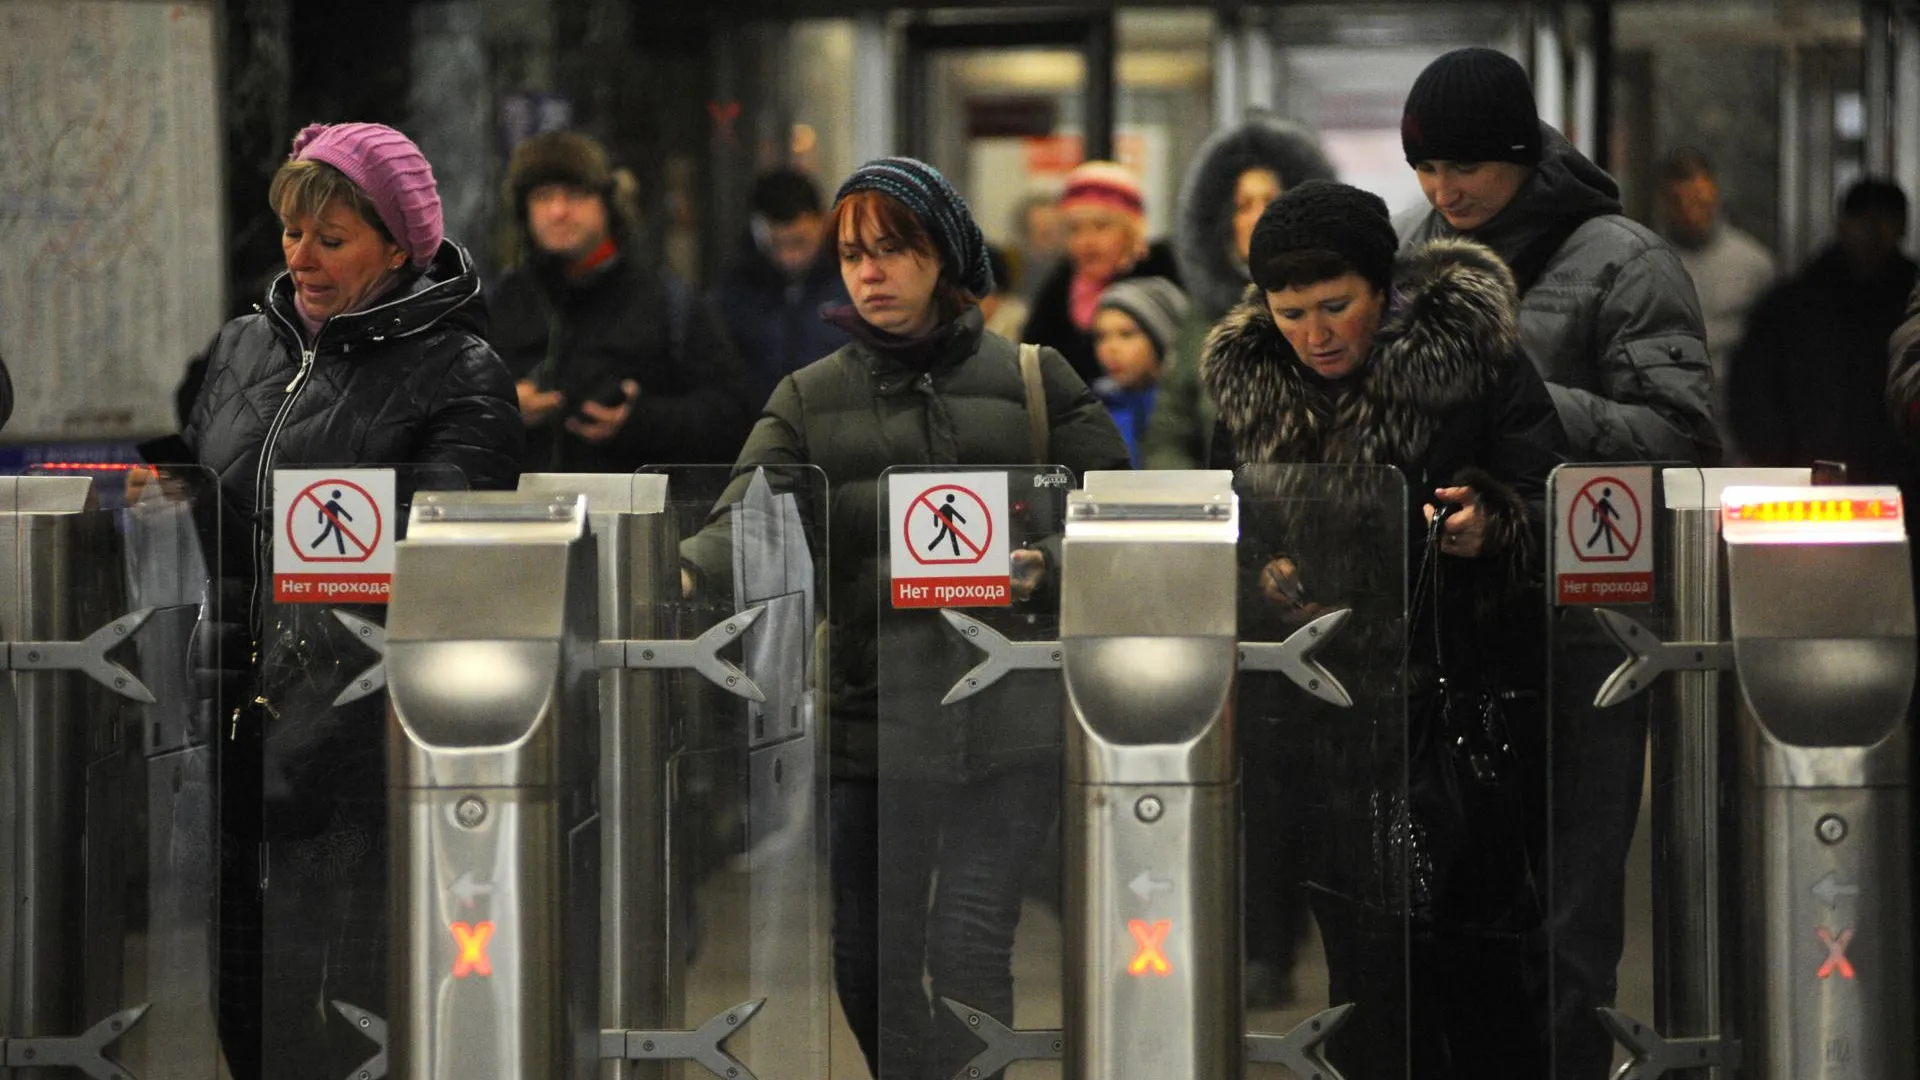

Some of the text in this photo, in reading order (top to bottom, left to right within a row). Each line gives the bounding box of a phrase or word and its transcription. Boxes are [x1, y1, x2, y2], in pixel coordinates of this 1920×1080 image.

[281, 579, 390, 596] Нет прохода
[899, 583, 1005, 602] Нет прохода
[1563, 580, 1649, 596] Нет прохода
